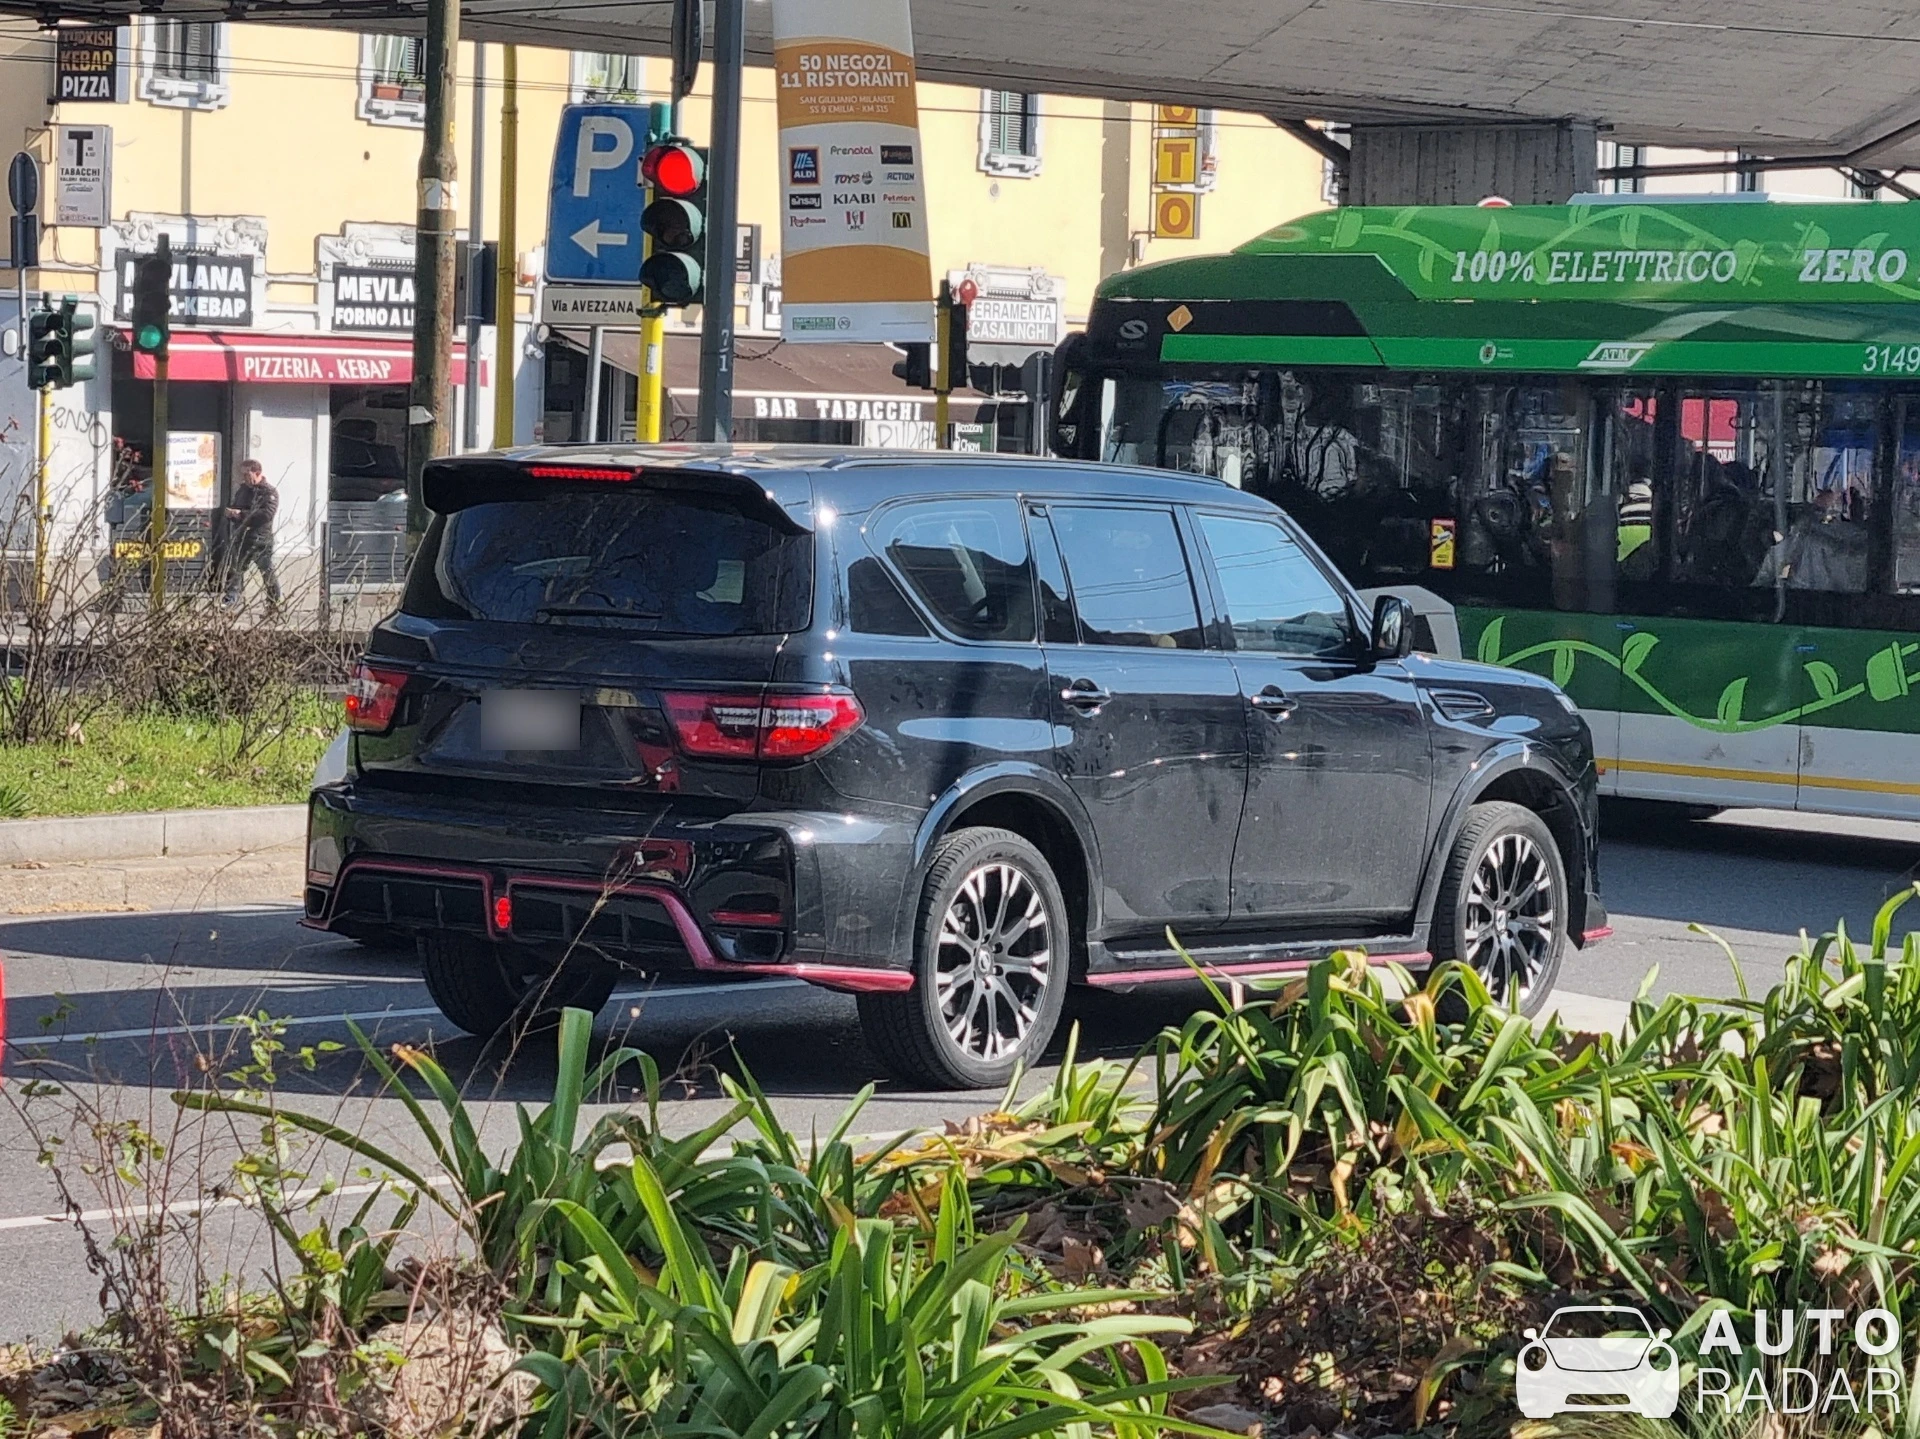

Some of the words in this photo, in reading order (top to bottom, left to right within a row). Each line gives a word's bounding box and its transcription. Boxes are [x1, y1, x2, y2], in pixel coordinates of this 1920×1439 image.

[62, 31, 113, 47] TURKISH
[61, 50, 113, 71] KEBAP
[800, 55, 821, 70] 50
[827, 55, 891, 70] NEGOZI
[62, 76, 110, 97] PIZZA
[781, 72, 801, 88] 11
[806, 72, 909, 88] RISTORANTI
[800, 96, 816, 104] SAN
[818, 96, 856, 104] GIULIANO
[859, 95, 895, 104] MILANESE
[68, 131, 93, 166] T
[573, 116, 633, 197] P
[60, 168, 100, 176] TABACCHI
[794, 170, 816, 178] ALDI
[834, 174, 860, 184] TOYS
[887, 172, 914, 180] ACTION
[833, 193, 876, 204] KIABI
[1450, 251, 1535, 283] 100%
[1546, 250, 1738, 283] ELETTRICO
[1798, 249, 1907, 283] ZERO
[338, 276, 415, 302] MEVLA
[123, 293, 247, 318] PA-KEBAP
[551, 300, 568, 312] Via
[571, 300, 634, 313] AVEZZANA
[975, 302, 1053, 321] ERRAMENTA
[335, 307, 388, 326] FORNO
[389, 308, 401, 326] A
[971, 321, 1049, 340] CASALINGHI
[1600, 349, 1630, 361] ATM
[1862, 345, 1920, 373] 3149
[244, 357, 324, 379] PIZZERIA
[336, 358, 391, 379] KEBAP
[755, 397, 798, 418] BAR
[816, 399, 922, 421] TABACCHI
[163, 542, 201, 559] EBAP
